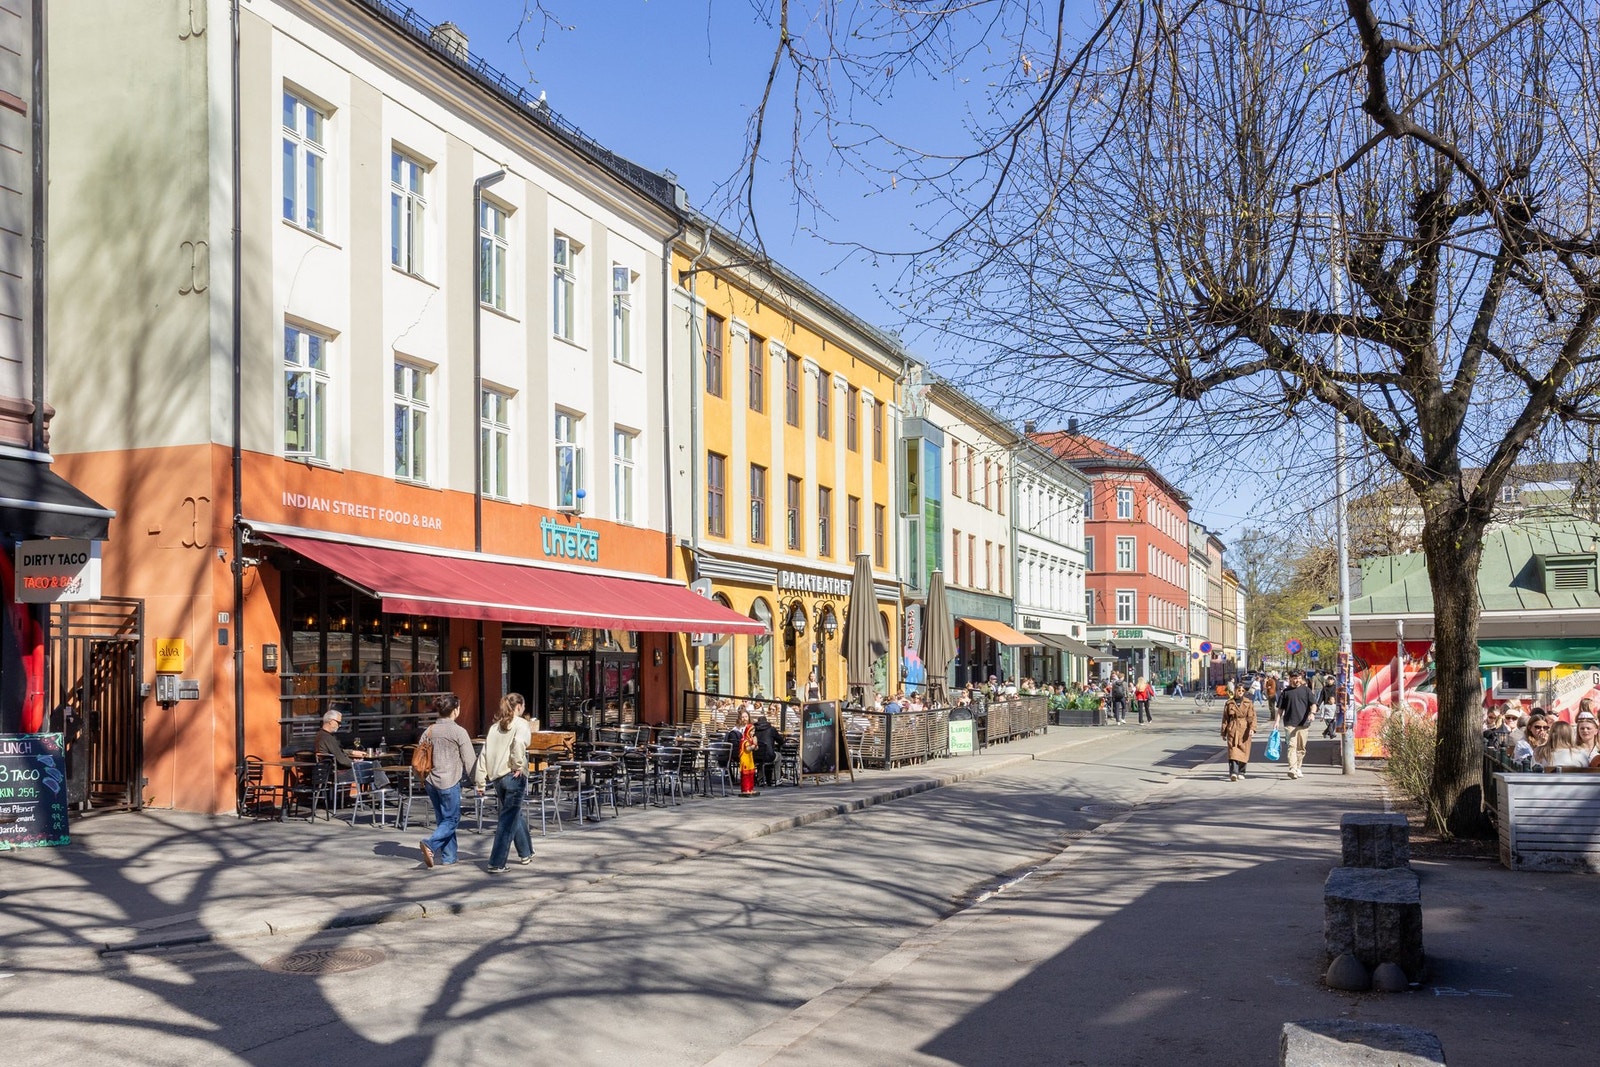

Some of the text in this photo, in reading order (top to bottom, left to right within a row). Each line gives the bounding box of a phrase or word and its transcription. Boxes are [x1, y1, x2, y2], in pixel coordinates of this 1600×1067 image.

[282, 491, 442, 530] INDIAN STREET FOOD & BAR
[540, 515, 600, 562] theka
[23, 553, 88, 567] DIRTY TACO
[23, 575, 50, 589] TACO
[51, 575, 58, 588] &
[782, 570, 851, 596] PARKTEATRET
[0, 742, 32, 754] UNCH
[10, 769, 40, 780] TACO
[12, 804, 36, 813] Pilsner
